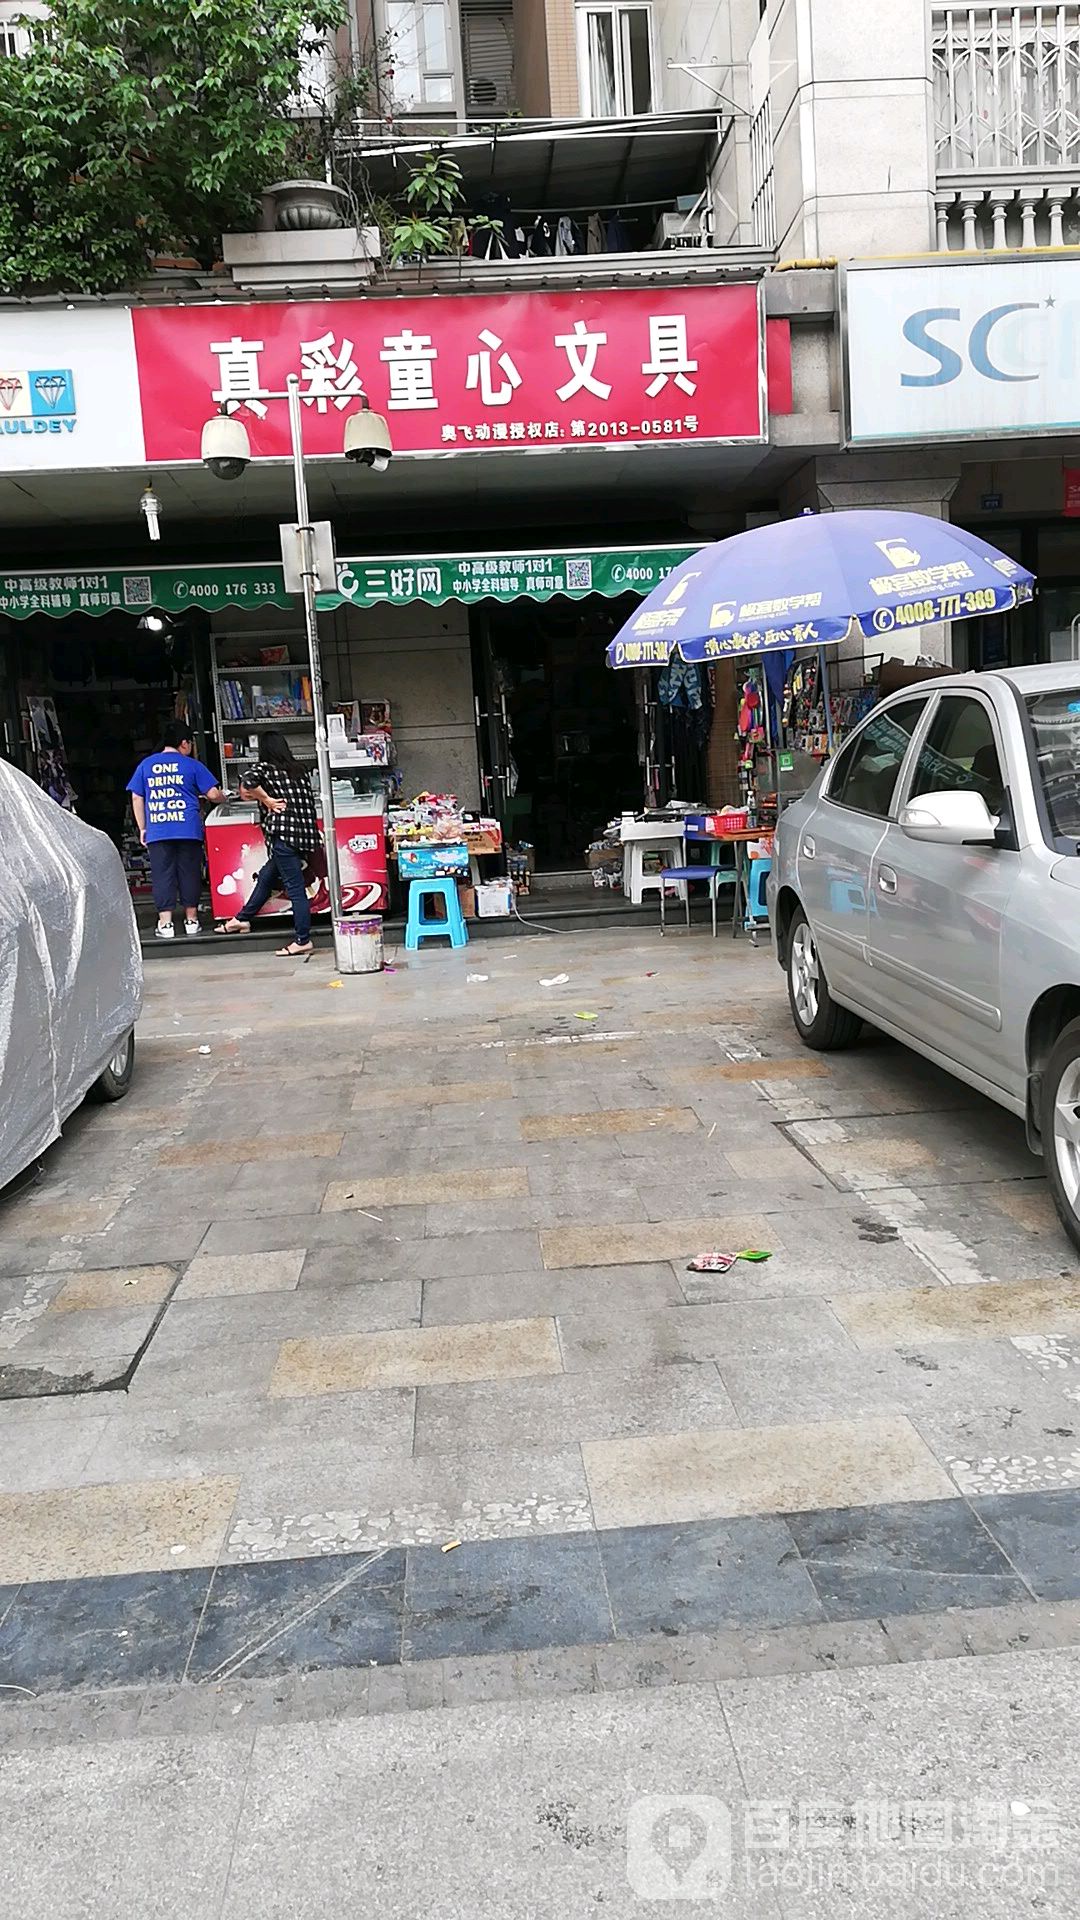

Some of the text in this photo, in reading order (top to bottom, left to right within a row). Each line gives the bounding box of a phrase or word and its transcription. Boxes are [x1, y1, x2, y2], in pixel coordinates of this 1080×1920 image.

[210, 315, 699, 417] 真彩童心文具
[458, 559, 553, 576] 中高级教师1对1
[626, 566, 678, 580] 4000 17
[4, 575, 108, 592] 中高级教师1对1
[189, 582, 276, 597] 4000 176 333
[364, 567, 441, 598] 三好网
[452, 576, 565, 594] 中小学全科辅导 真师可靠
[0, 591, 121, 610] 中小学全科辅导 真师可靠
[895, 588, 996, 626] 4008-777-389
[152, 763, 179, 774] ONE
[147, 775, 184, 787] DRINK
[150, 788, 182, 799] AND..
[148, 800, 187, 811] WE GO
[150, 811, 185, 823] HOME
